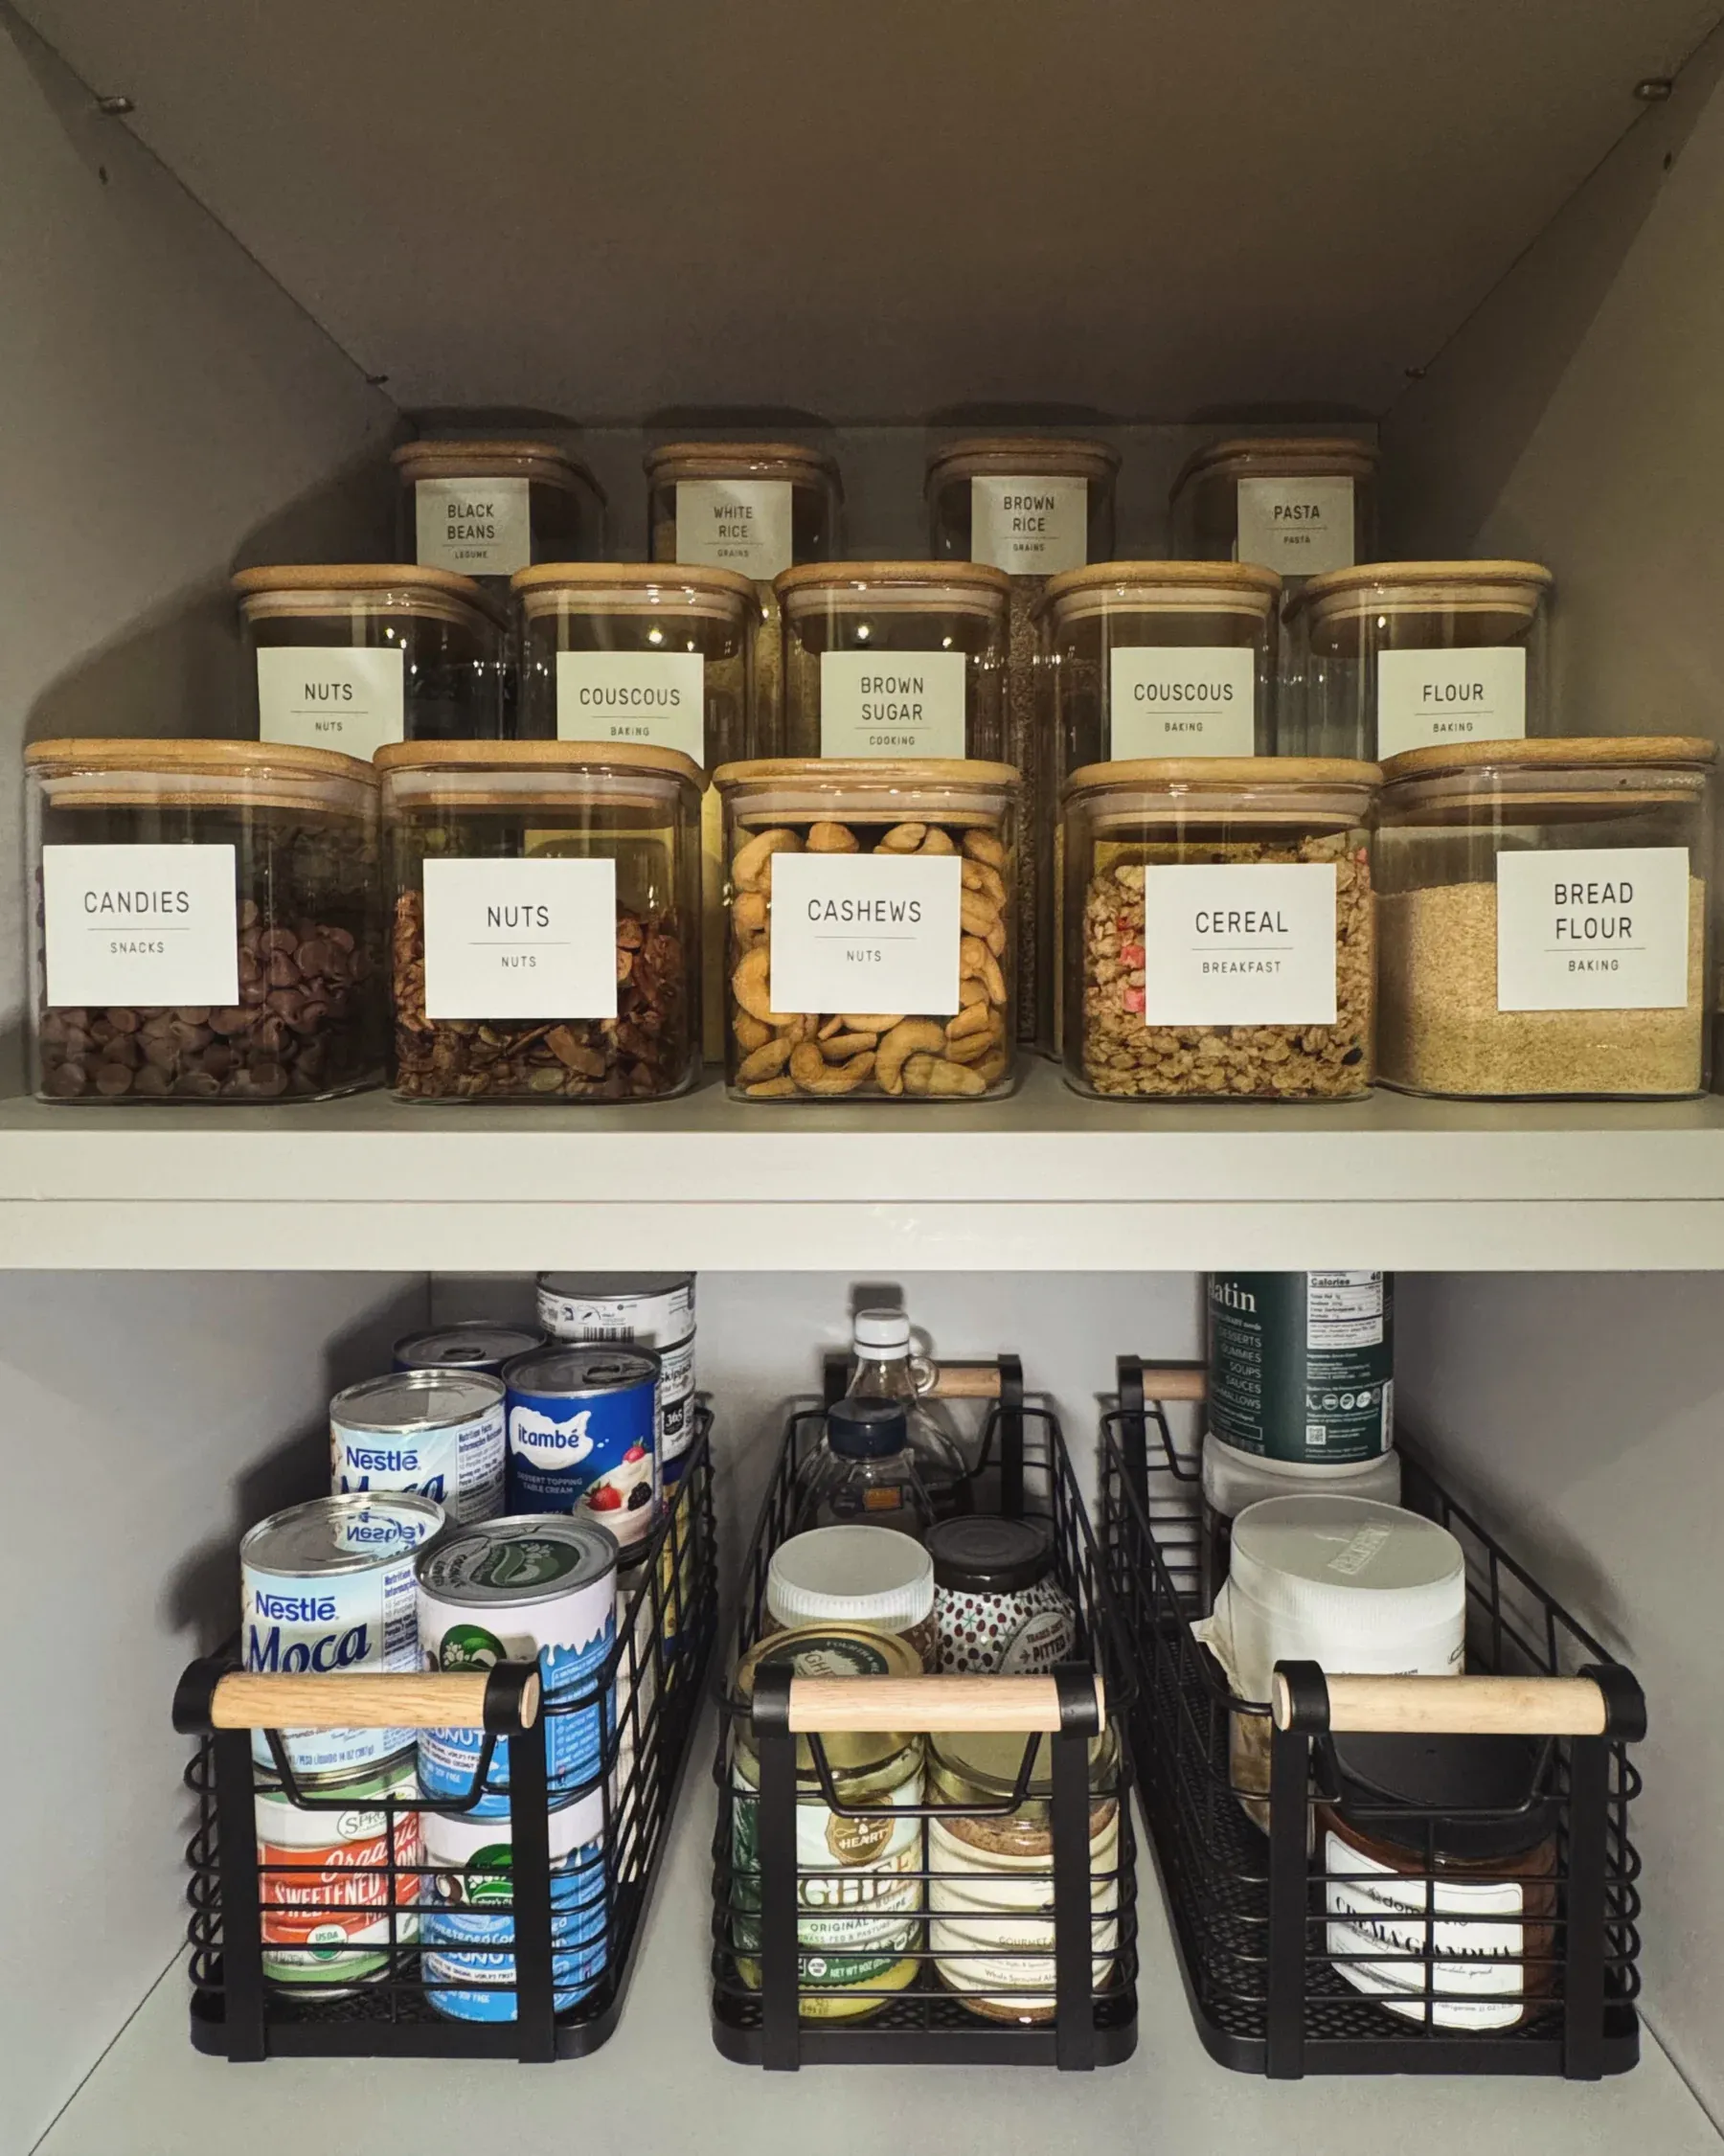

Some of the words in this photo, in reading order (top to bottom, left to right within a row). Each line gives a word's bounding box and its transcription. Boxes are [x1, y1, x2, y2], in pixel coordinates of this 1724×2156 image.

[447, 503, 494, 519] BLACK
[713, 504, 753, 519] WHITE
[1003, 495, 1055, 513] BROWN
[1274, 505, 1321, 520] PASTA
[447, 524, 495, 540] BEANS
[718, 524, 748, 538] RICE
[1012, 516, 1047, 533] RICE
[1283, 534, 1311, 545] PASTA
[454, 550, 488, 559] LEGUME
[716, 549, 749, 557] GRAINS
[1013, 542, 1047, 553] GRAINS
[305, 683, 353, 701] NUTS
[860, 676, 924, 694] BROWN
[1134, 683, 1234, 701] COUSCOUS
[1422, 683, 1484, 702] FLOUR
[579, 688, 681, 707] COUSCOUS
[861, 703, 922, 721] SUGAR
[314, 721, 343, 732] NUTS
[610, 726, 650, 737] BAKING
[1164, 721, 1204, 733] BAKING
[1433, 722, 1473, 733] BAKING
[869, 736, 916, 746] COOKING
[1554, 881, 1633, 905] BREAD
[84, 891, 190, 914] CANDIES
[488, 905, 550, 928] NUTS
[807, 898, 921, 923] CASHEWS
[1195, 911, 1289, 934] CEREAL
[1555, 917, 1632, 940] FLOUR
[110, 941, 165, 954] SNACKS
[501, 955, 536, 968] NUTS
[847, 949, 882, 963] NUTS
[1202, 961, 1282, 974] BREAKFAST
[1568, 959, 1619, 972] BAKING
[1310, 1278, 1350, 1286] Calories
[1229, 1361, 1261, 1378] SOUPS
[1225, 1374, 1261, 1395] SAUCES
[517, 1422, 579, 1449] itambé
[346, 1444, 419, 1472] Nestlé
[517, 1471, 545, 1484] DESSERT
[547, 1476, 583, 1487] TOPPING
[523, 1482, 544, 1494] TABLE
[545, 1485, 574, 1494] CREAM
[256, 1589, 336, 1623] Nestlé
[843, 1829, 889, 1850] HEART
[809, 1918, 870, 1933] ORIGINAL
[315, 1932, 338, 1941] USDA
[998, 1936, 1051, 1948] GOURMET
[828, 1967, 845, 1979] NET
[846, 1965, 858, 1977] WT
[985, 1969, 1007, 1982] Whole
